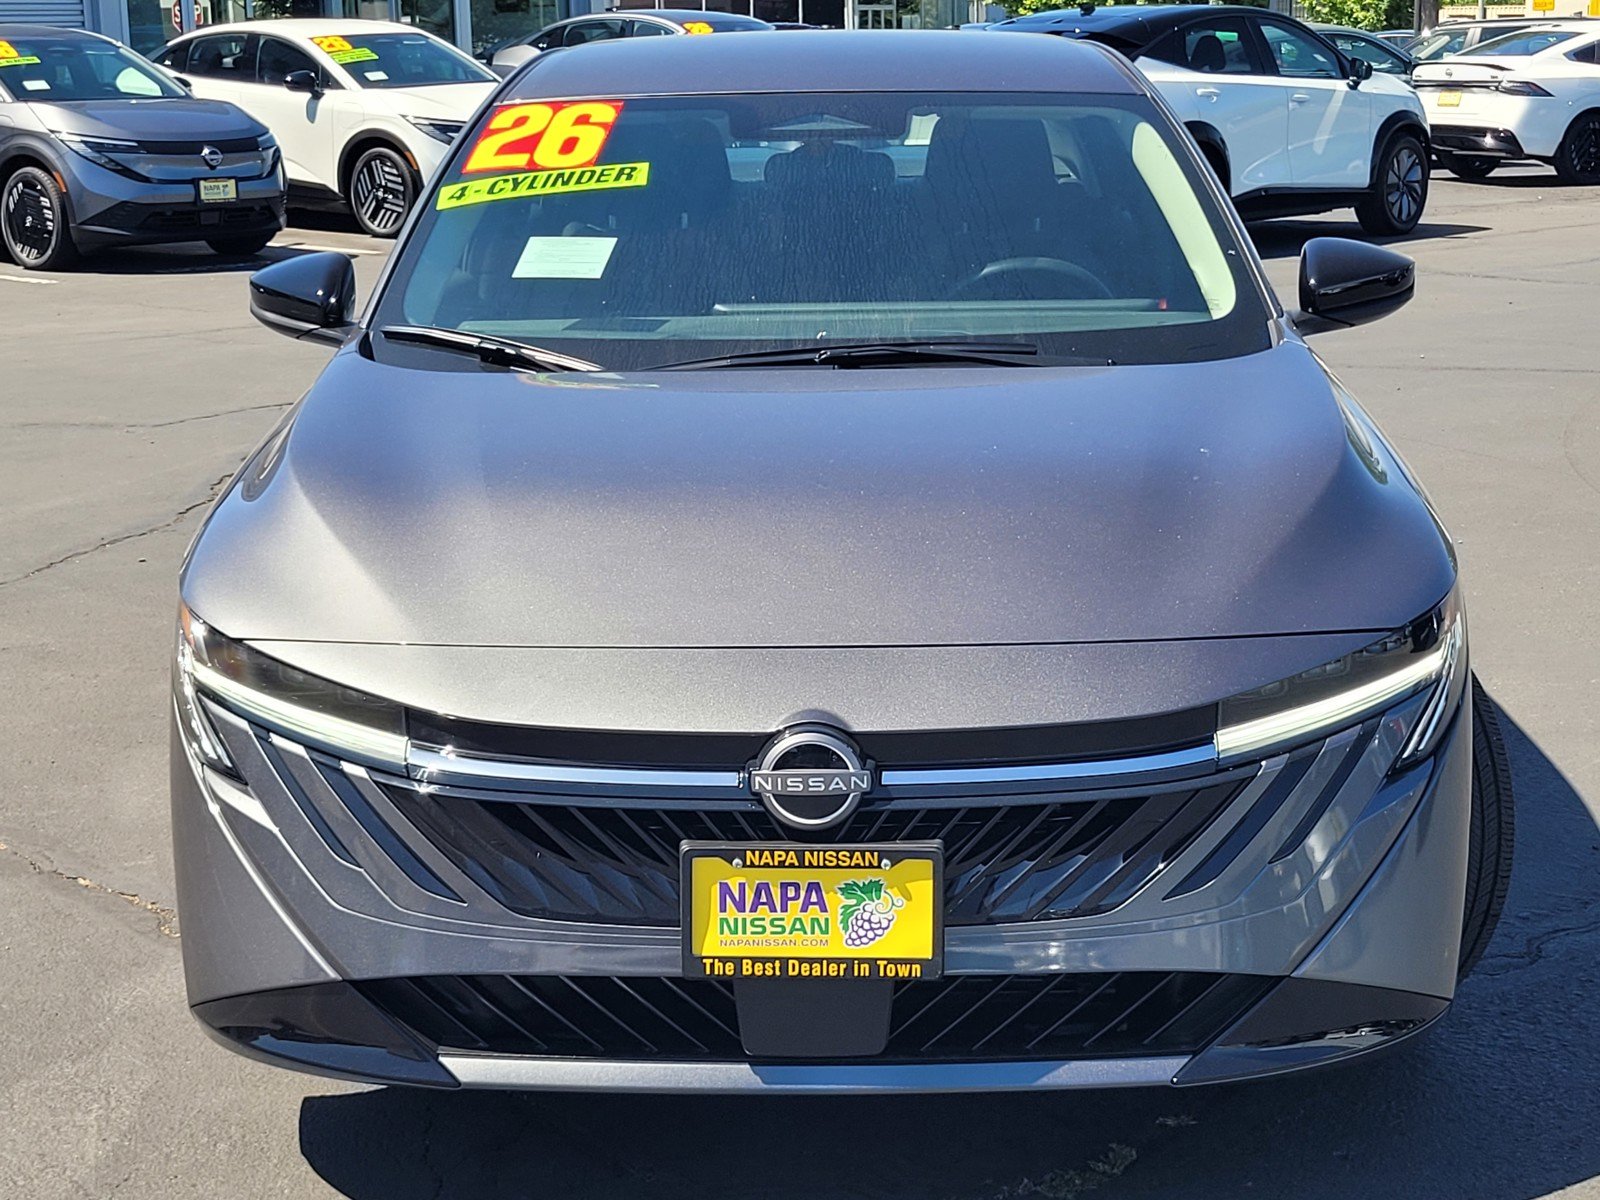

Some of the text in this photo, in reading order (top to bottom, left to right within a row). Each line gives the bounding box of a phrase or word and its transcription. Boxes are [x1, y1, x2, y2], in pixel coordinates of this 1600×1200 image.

[174, 5, 201, 23] SP
[312, 36, 353, 52] 26
[465, 102, 617, 171] 26
[754, 774, 869, 792] NISSAN
[746, 850, 878, 867] NAPA NISSAN
[719, 881, 829, 914] NAPA
[719, 917, 830, 936] NISSAN
[719, 939, 829, 947] NAPANISSAN.COM
[703, 958, 921, 978] The Best Dealer in Town
